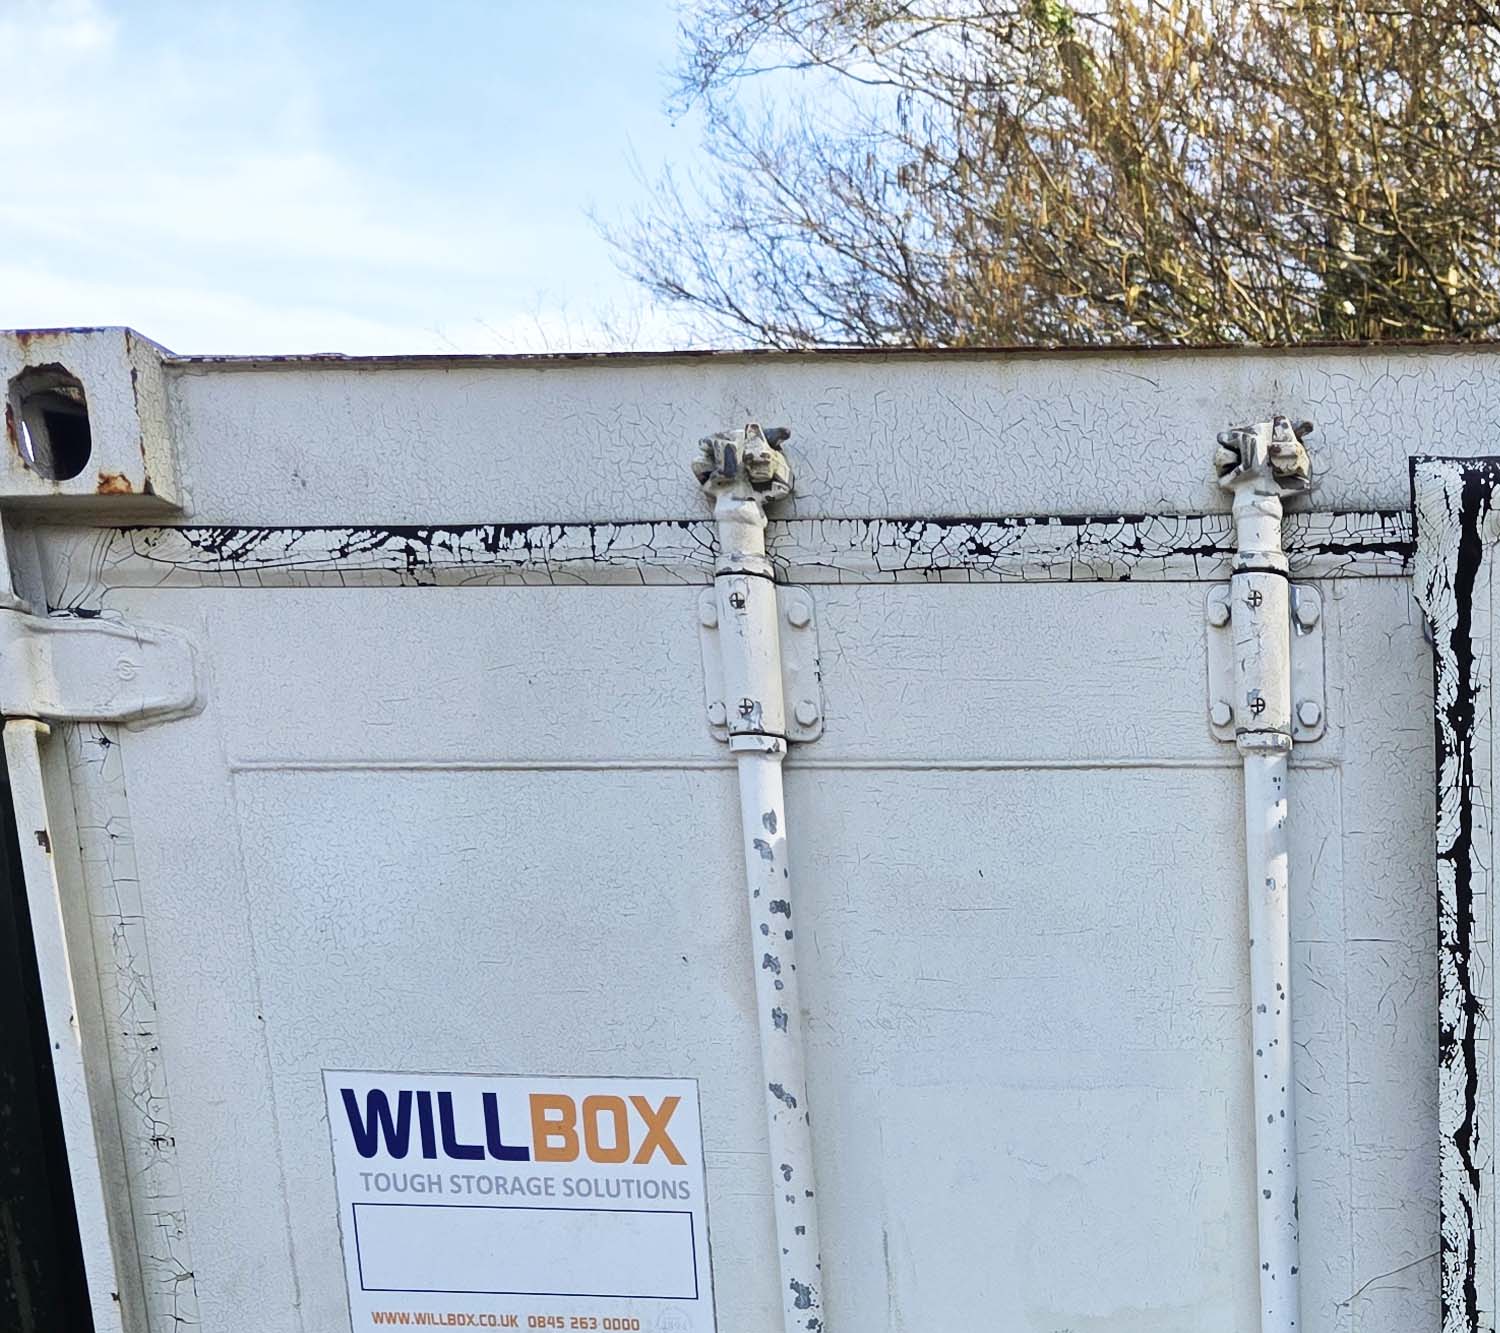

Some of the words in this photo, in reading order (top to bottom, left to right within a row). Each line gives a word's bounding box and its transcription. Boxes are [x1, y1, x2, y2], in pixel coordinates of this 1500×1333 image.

[340, 1088, 688, 1165] WILLBOX
[360, 1172, 442, 1194] TOUGH
[450, 1174, 555, 1197] STORAGE
[563, 1176, 690, 1200] SOLUTIONS
[371, 1311, 519, 1328] WWW.WILLBOX.CO.UK
[528, 1315, 565, 1330] 0845
[570, 1315, 598, 1330] 263
[602, 1317, 641, 1332] 0000
